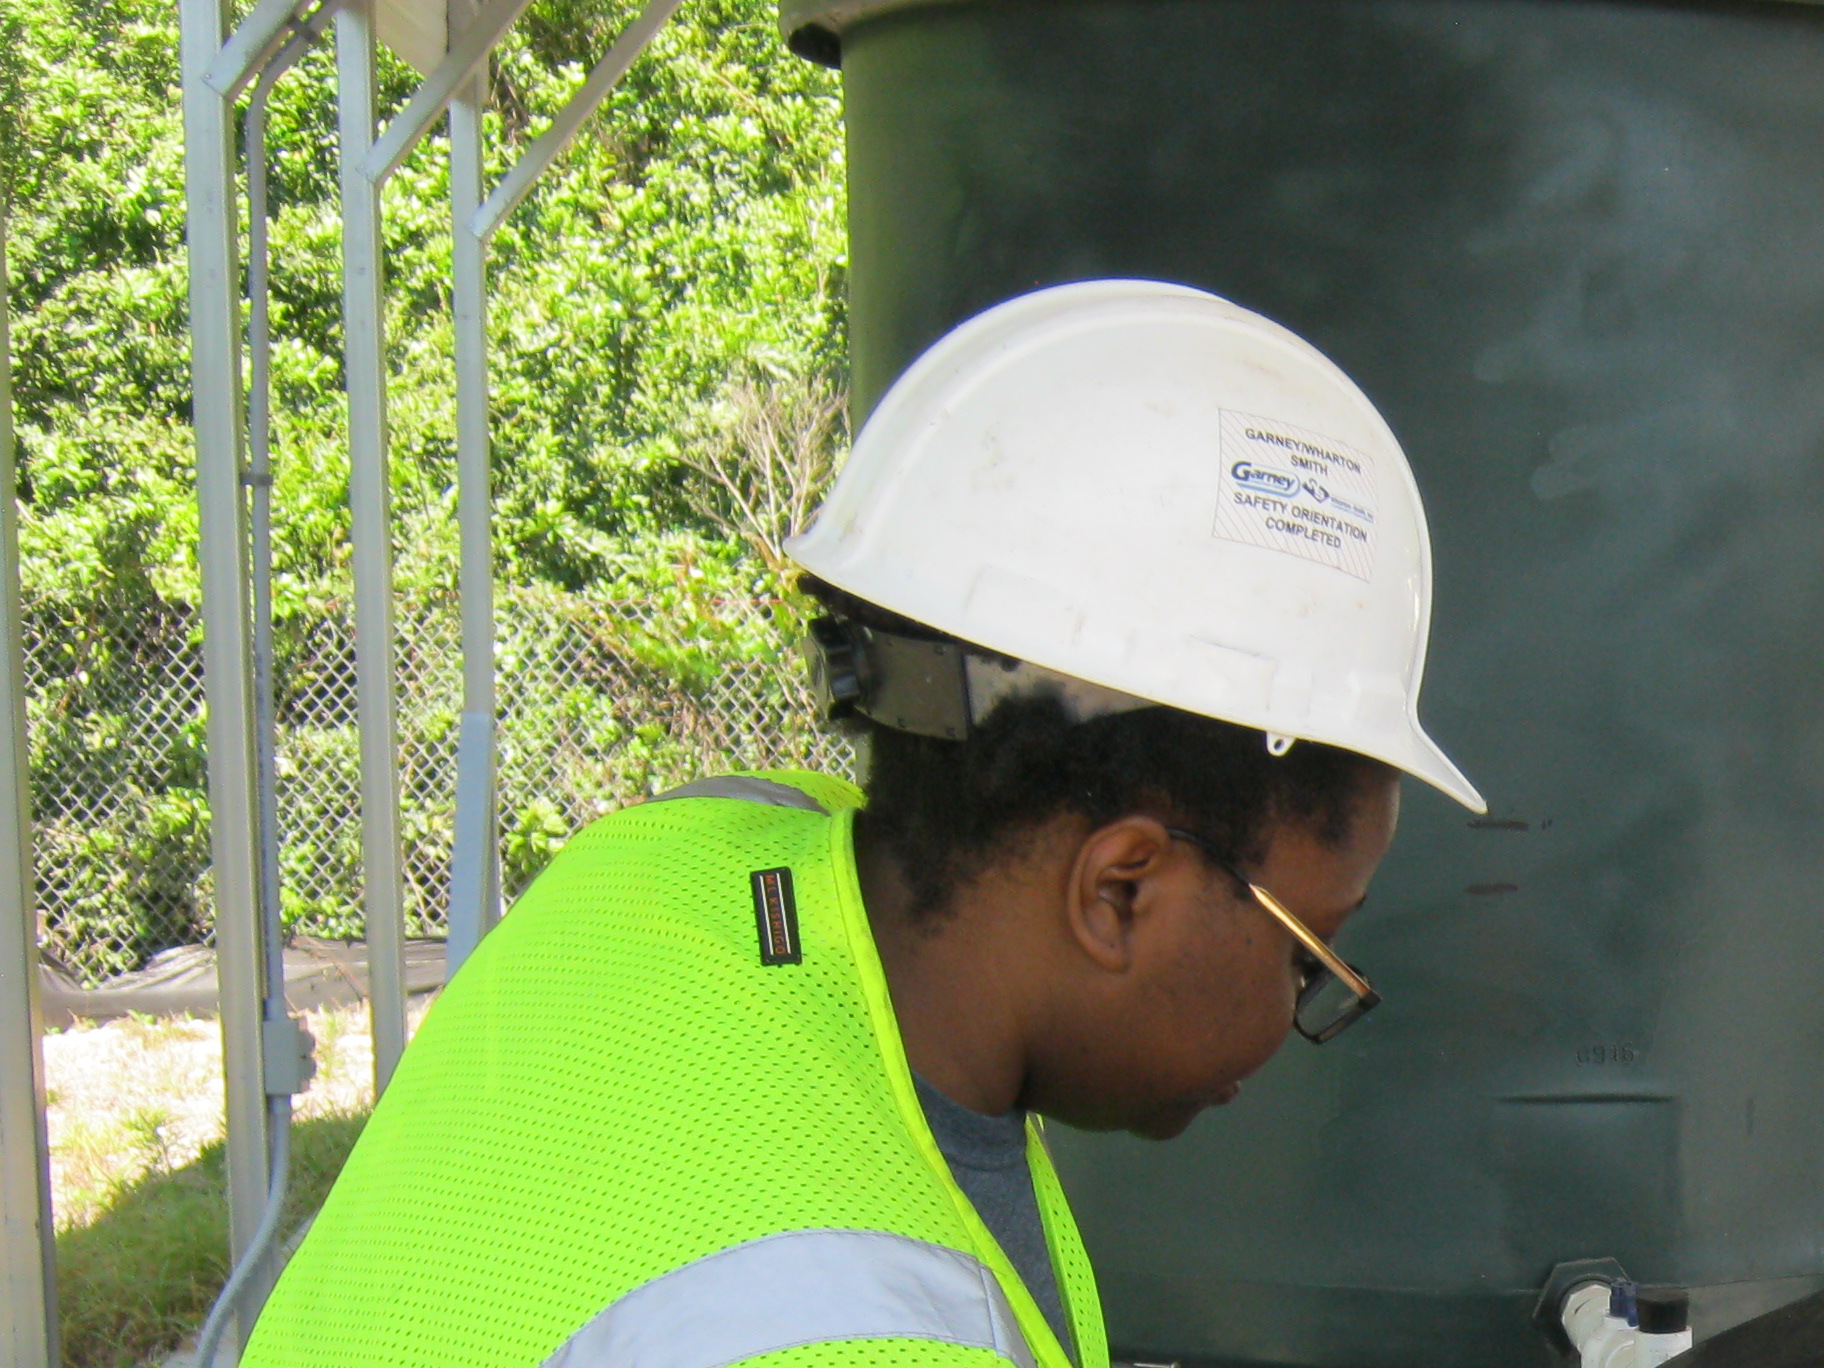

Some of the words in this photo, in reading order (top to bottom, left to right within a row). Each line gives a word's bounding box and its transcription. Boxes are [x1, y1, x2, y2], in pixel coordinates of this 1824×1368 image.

[1231, 460, 1295, 491] Garney
[1290, 454, 1328, 476] SMITH
[1233, 491, 1288, 514] SAFETY
[1291, 504, 1367, 542] ORIENTATION
[1265, 517, 1342, 549] COMPLETED
[769, 897, 785, 954] KISHIGO
